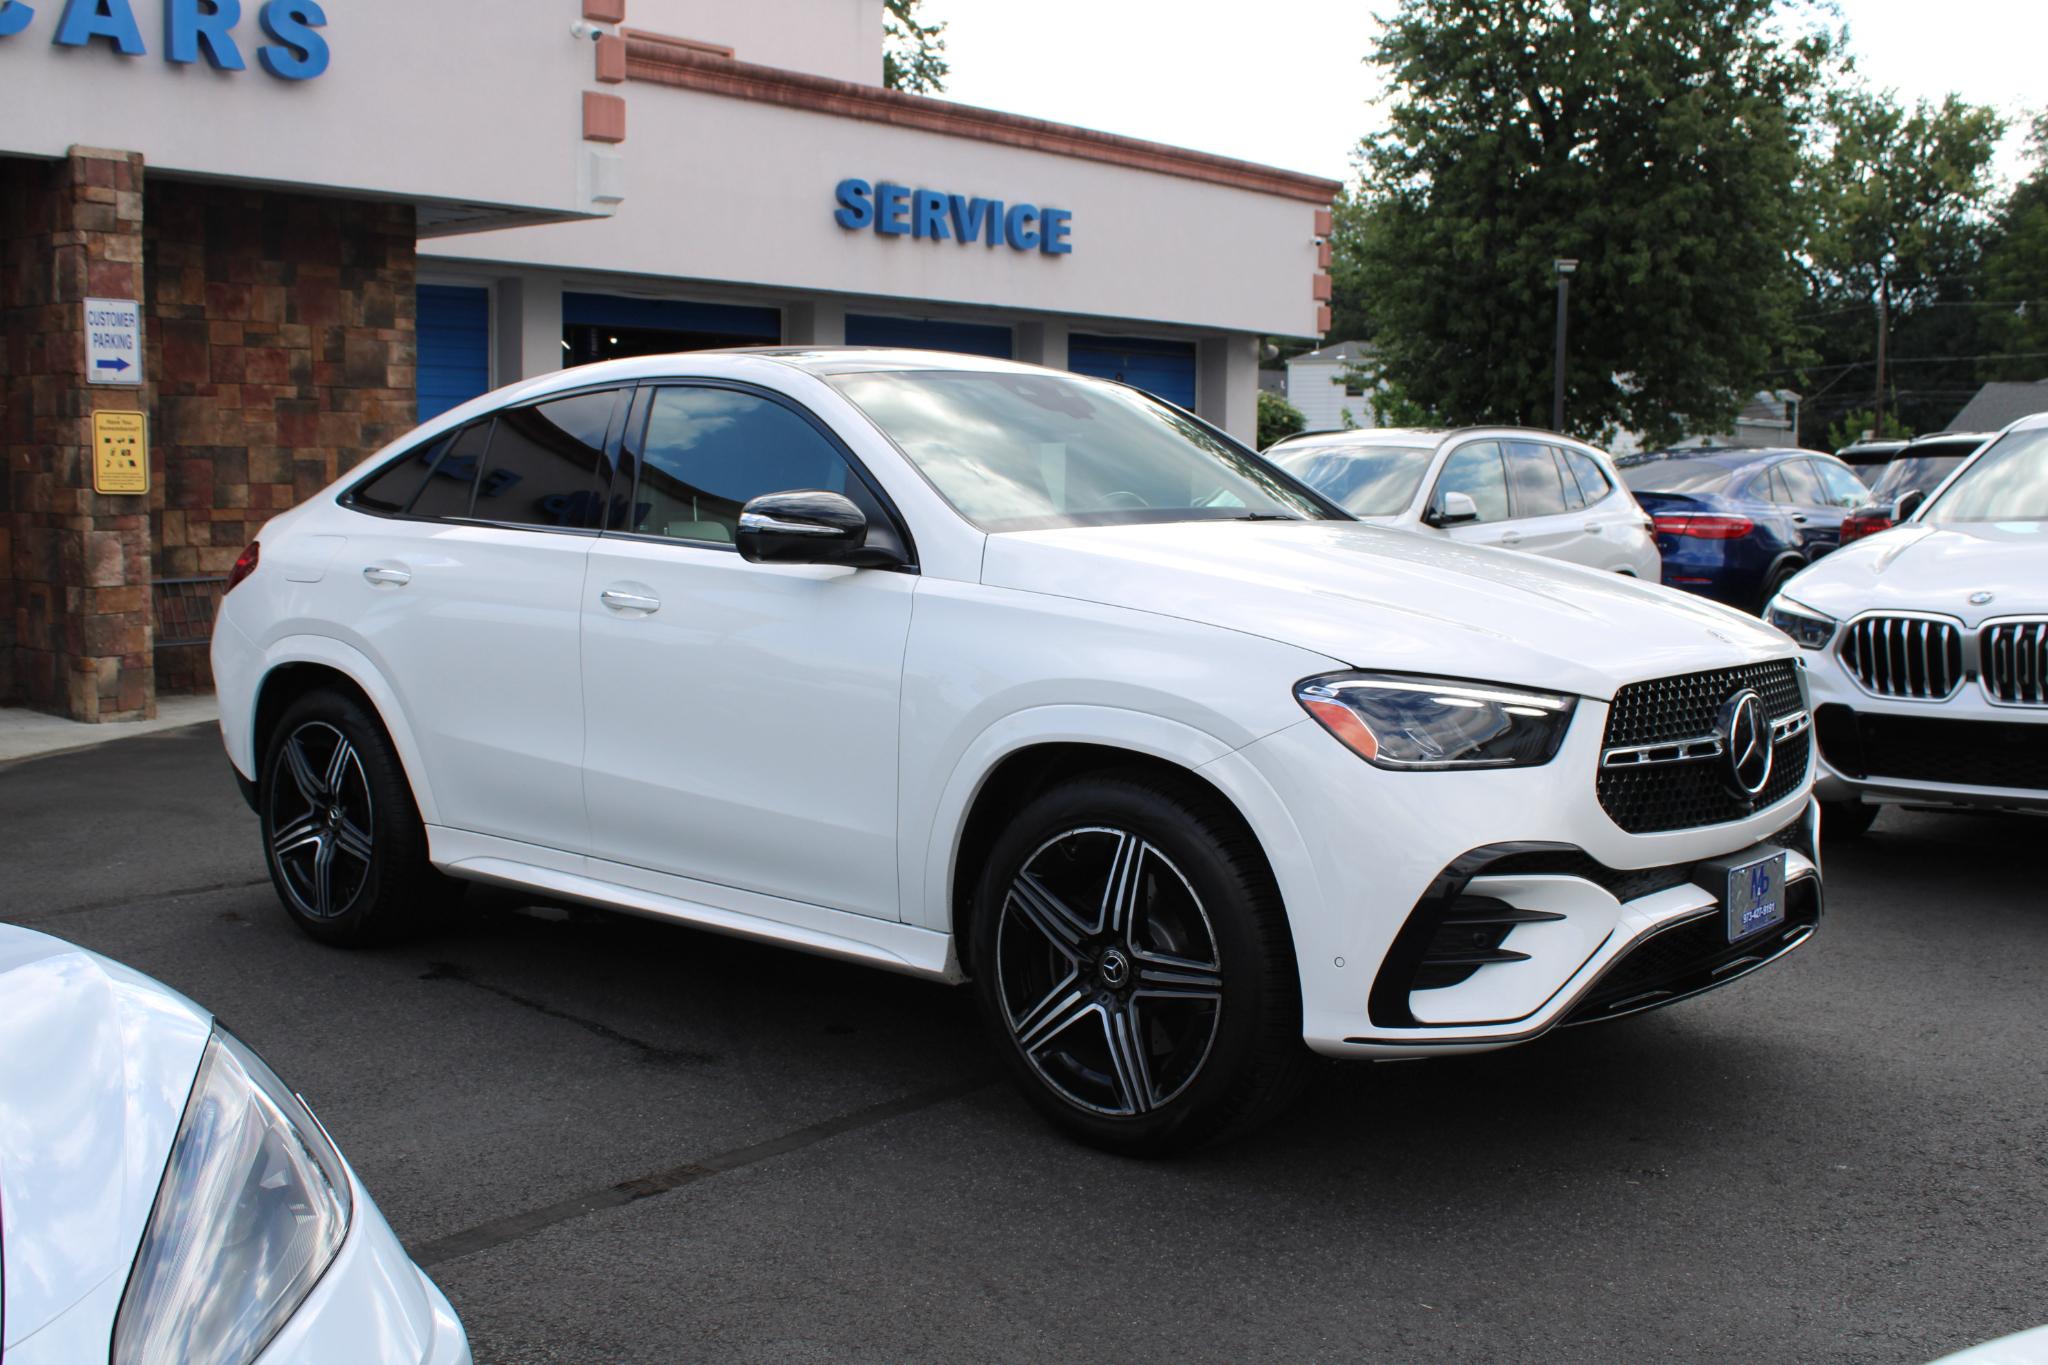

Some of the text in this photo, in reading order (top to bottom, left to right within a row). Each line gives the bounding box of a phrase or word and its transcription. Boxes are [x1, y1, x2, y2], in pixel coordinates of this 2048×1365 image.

[0, 0, 330, 81] ARS
[834, 178, 1072, 255] SERVICE
[88, 310, 135, 328] CUSTOMER
[93, 332, 132, 350] PARKING
